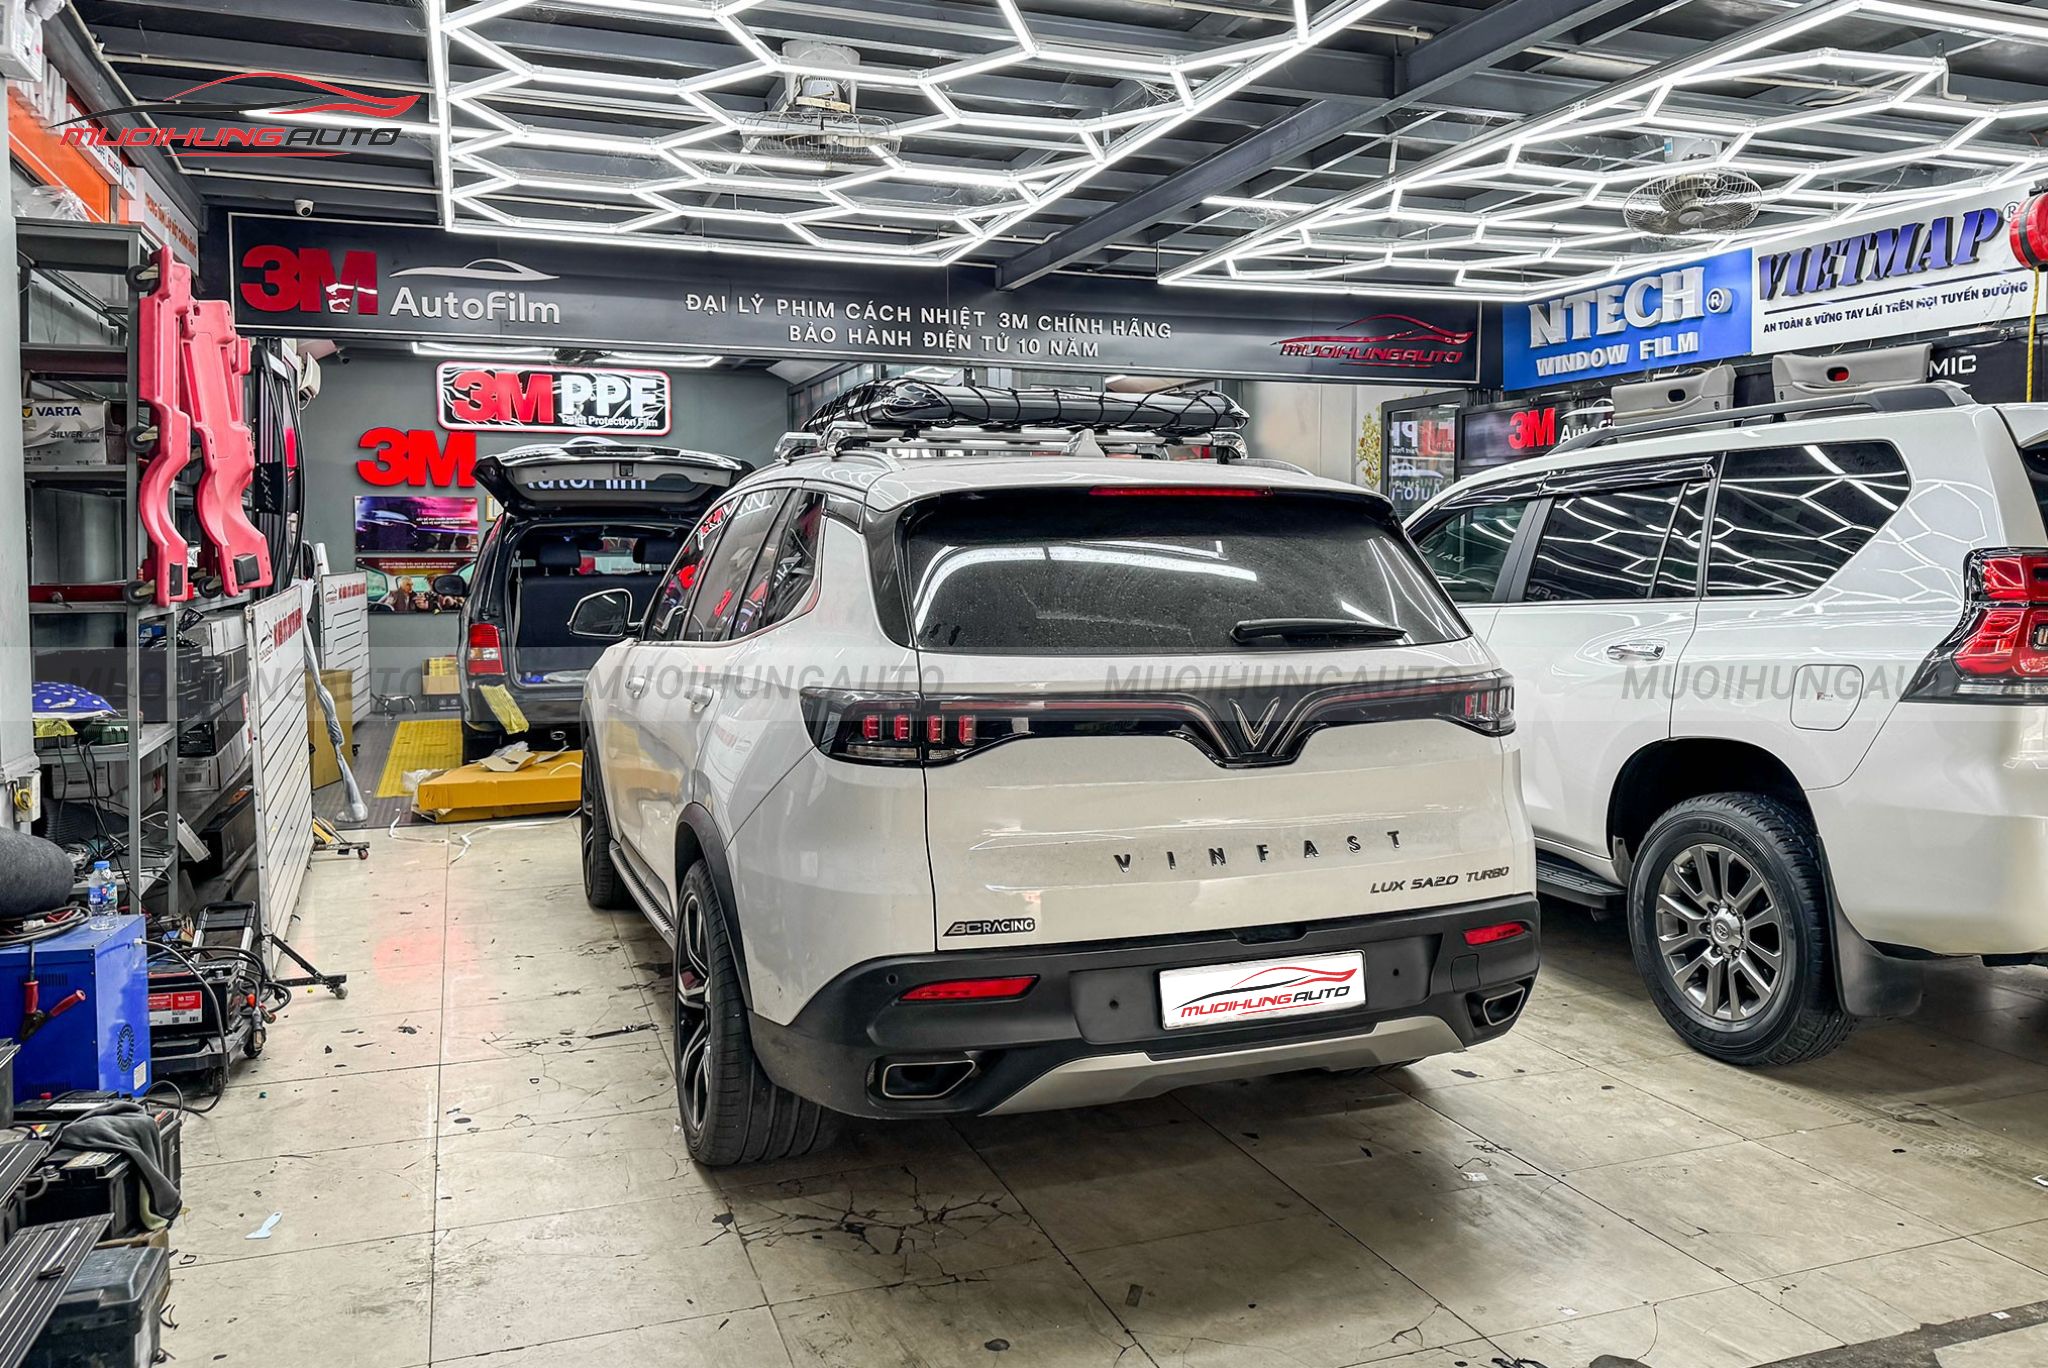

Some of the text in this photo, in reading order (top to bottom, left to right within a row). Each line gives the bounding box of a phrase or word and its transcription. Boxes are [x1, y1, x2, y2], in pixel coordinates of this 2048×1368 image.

[1758, 207, 2003, 301] VIETMAP
[239, 245, 560, 325] 3M AutoFilm
[1528, 266, 1706, 349] NTECH
[686, 293, 726, 316] ĐẠI
[776, 298, 836, 319] PHIM
[845, 300, 912, 323] CÁCH
[920, 306, 986, 330] NHIỆT
[998, 312, 1028, 330] 3M
[1037, 313, 1103, 335] CHÍNH
[1112, 317, 1172, 339] HÃNG
[1763, 322, 1777, 333] AN
[1778, 317, 1804, 331] TOÀN
[1805, 317, 1812, 326] &
[1814, 312, 1843, 325] VỮNG
[1845, 308, 1864, 321] TAY
[1866, 303, 1883, 317] LÁI
[1885, 299, 1914, 314] TRÊN
[1916, 295, 1938, 310] MỌI
[1940, 286, 1980, 305] TUYẾN
[788, 321, 1099, 357] BẢO HÀNH ĐIỆN TỬ 10 NĂM
[1536, 331, 1699, 377] WINDOW FILM
[36, 406, 82, 417] VARTA
[453, 370, 658, 424] 3M PPF
[588, 414, 637, 427] Protection
[637, 417, 659, 429] Film
[1508, 407, 1557, 450] 3M
[355, 427, 479, 488] 3M
[1113, 830, 1400, 873] VINFAST
[1370, 879, 1406, 894] LUX
[1466, 866, 1510, 883] TURBO
